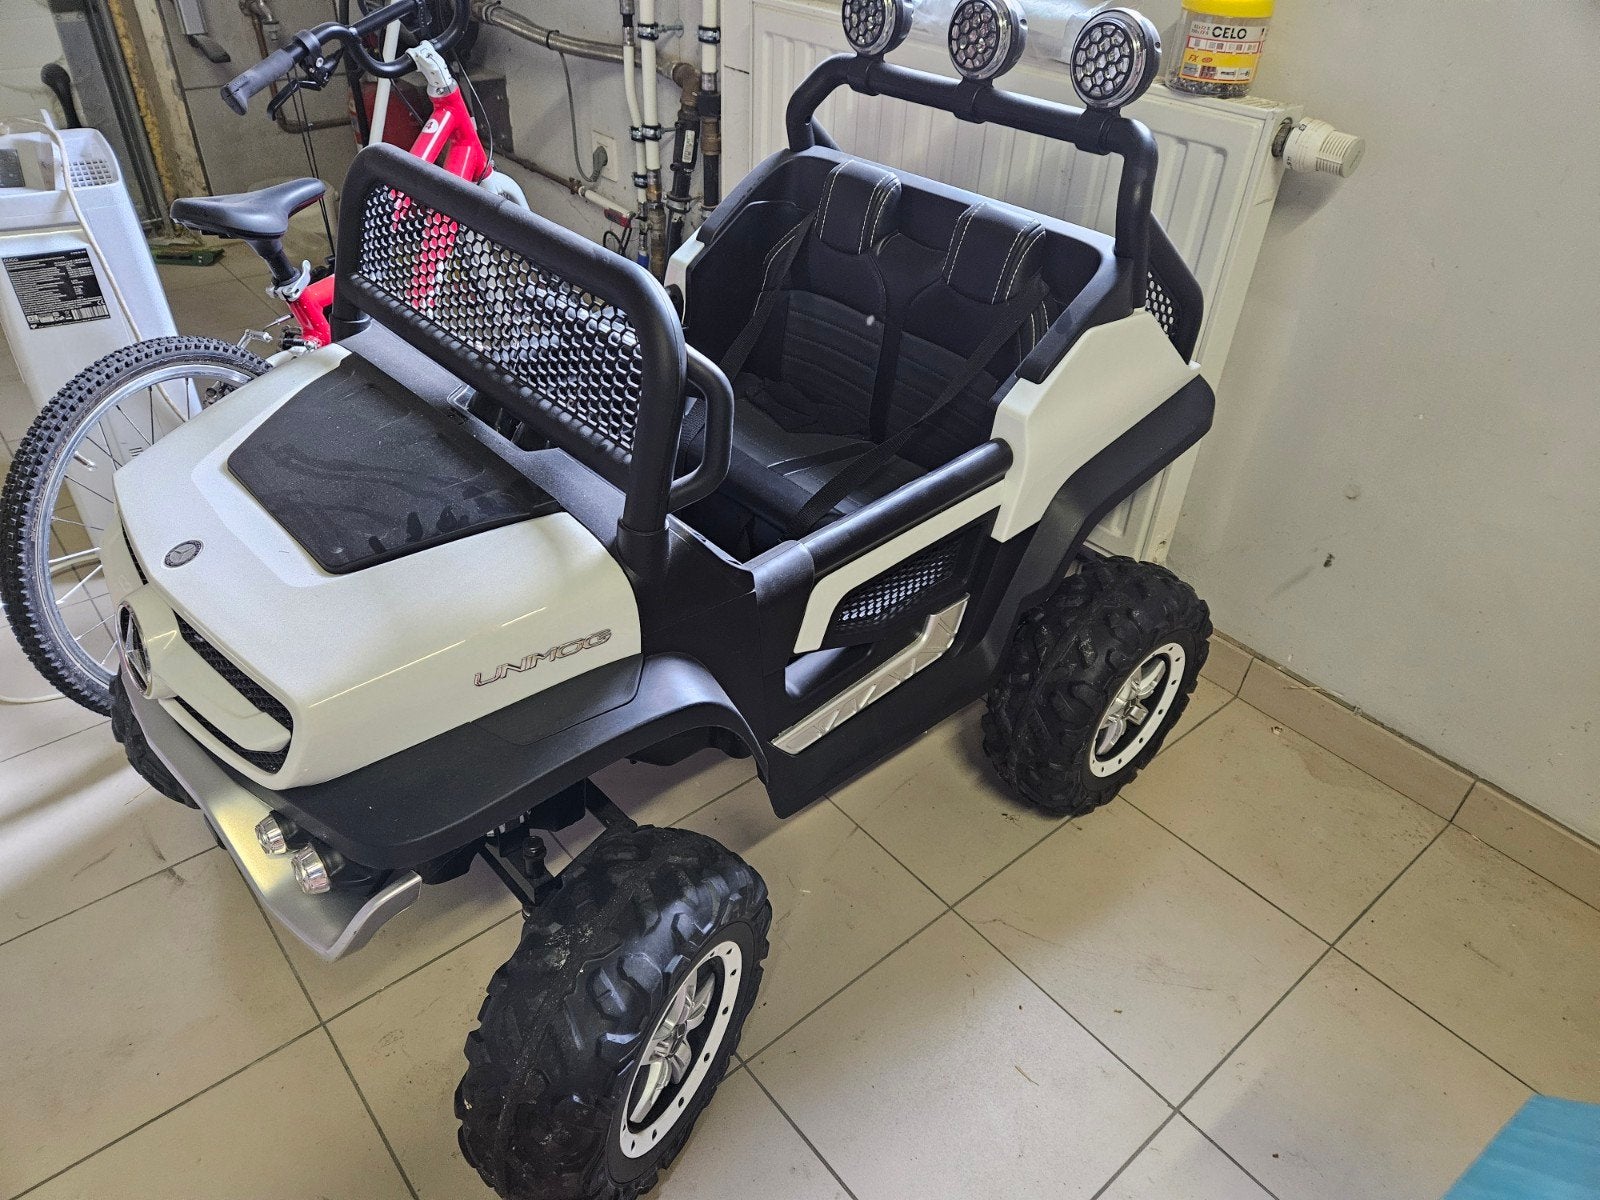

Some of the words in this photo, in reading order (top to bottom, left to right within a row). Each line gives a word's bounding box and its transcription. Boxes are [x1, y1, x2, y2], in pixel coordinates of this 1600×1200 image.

[1212, 26, 1247, 39] CELO
[1188, 54, 1199, 62] FX
[474, 628, 612, 687] UNIMOG
